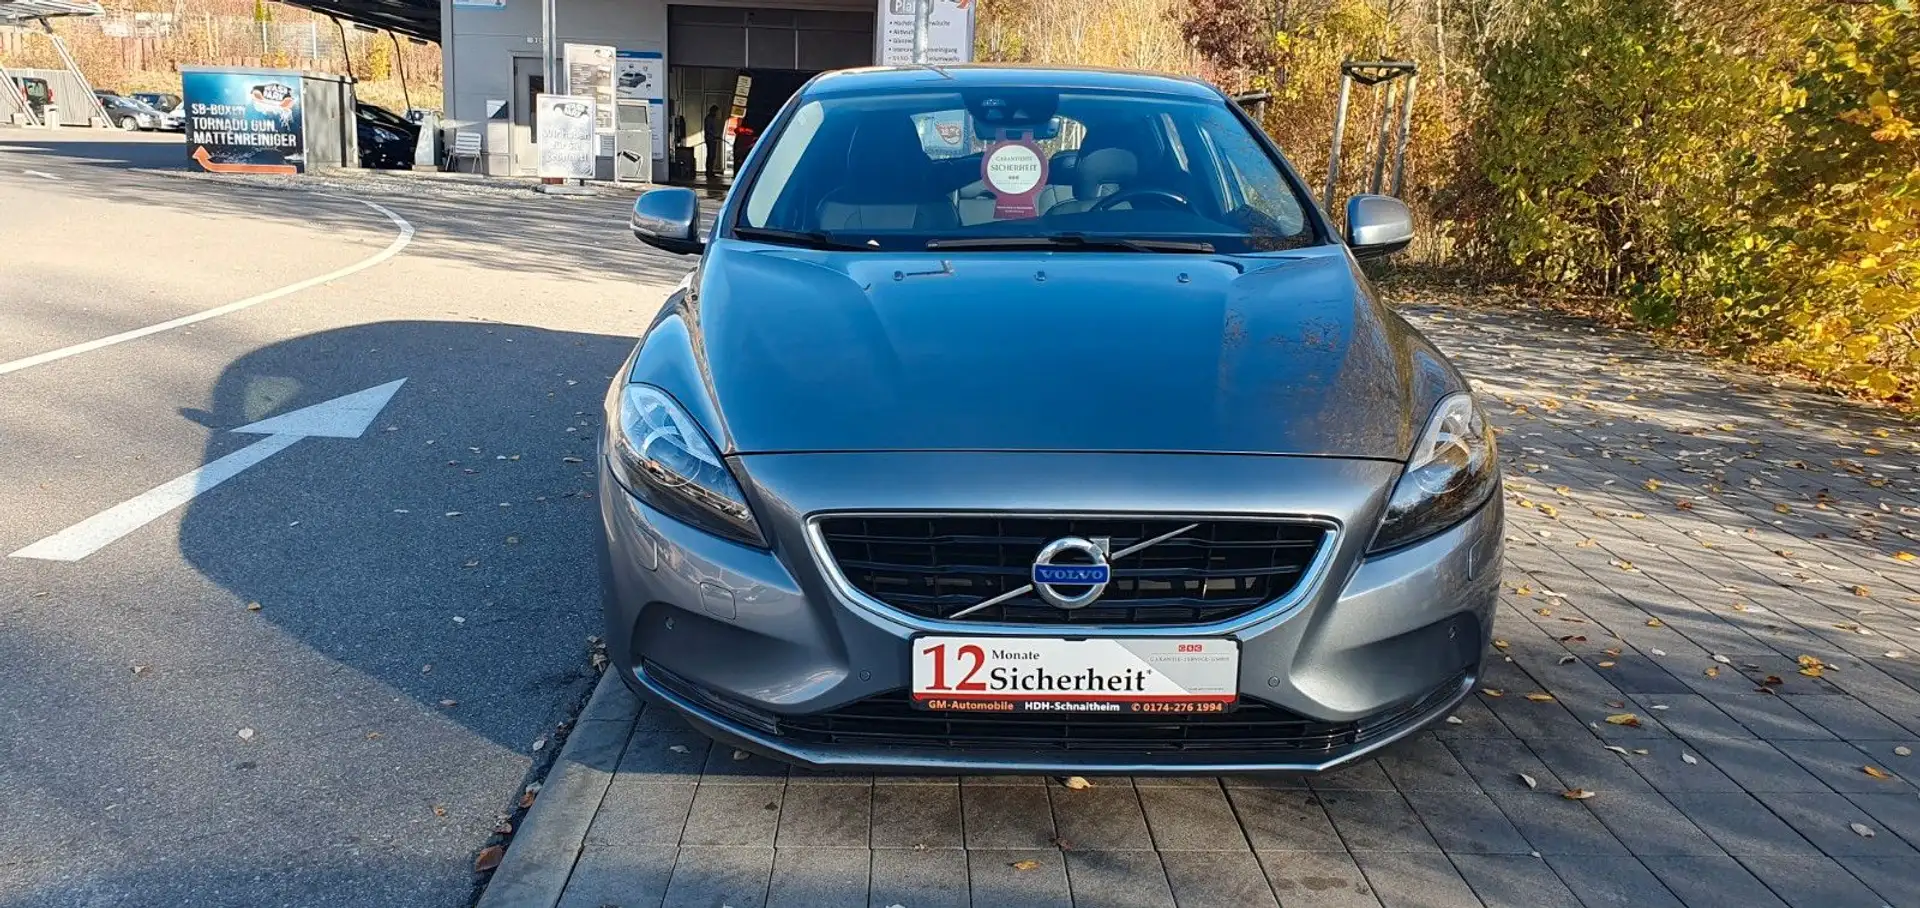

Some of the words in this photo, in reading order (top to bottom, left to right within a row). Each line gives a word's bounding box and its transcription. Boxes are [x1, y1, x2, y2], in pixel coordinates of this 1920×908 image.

[191, 103, 246, 116] SB-BOXEN
[192, 116, 248, 131] TORNADO
[193, 131, 297, 147] MATTENREINIGER
[990, 164, 1037, 172] SICHERHEIT
[1038, 568, 1104, 580] VOLVO
[992, 650, 1040, 661] Monate
[923, 643, 987, 691] 12
[928, 700, 1014, 711] GM-Automobile
[1025, 701, 1120, 712] HDH-Schnaitheim
[1143, 702, 1194, 712] 0174-276
[1196, 703, 1222, 712] 1994
